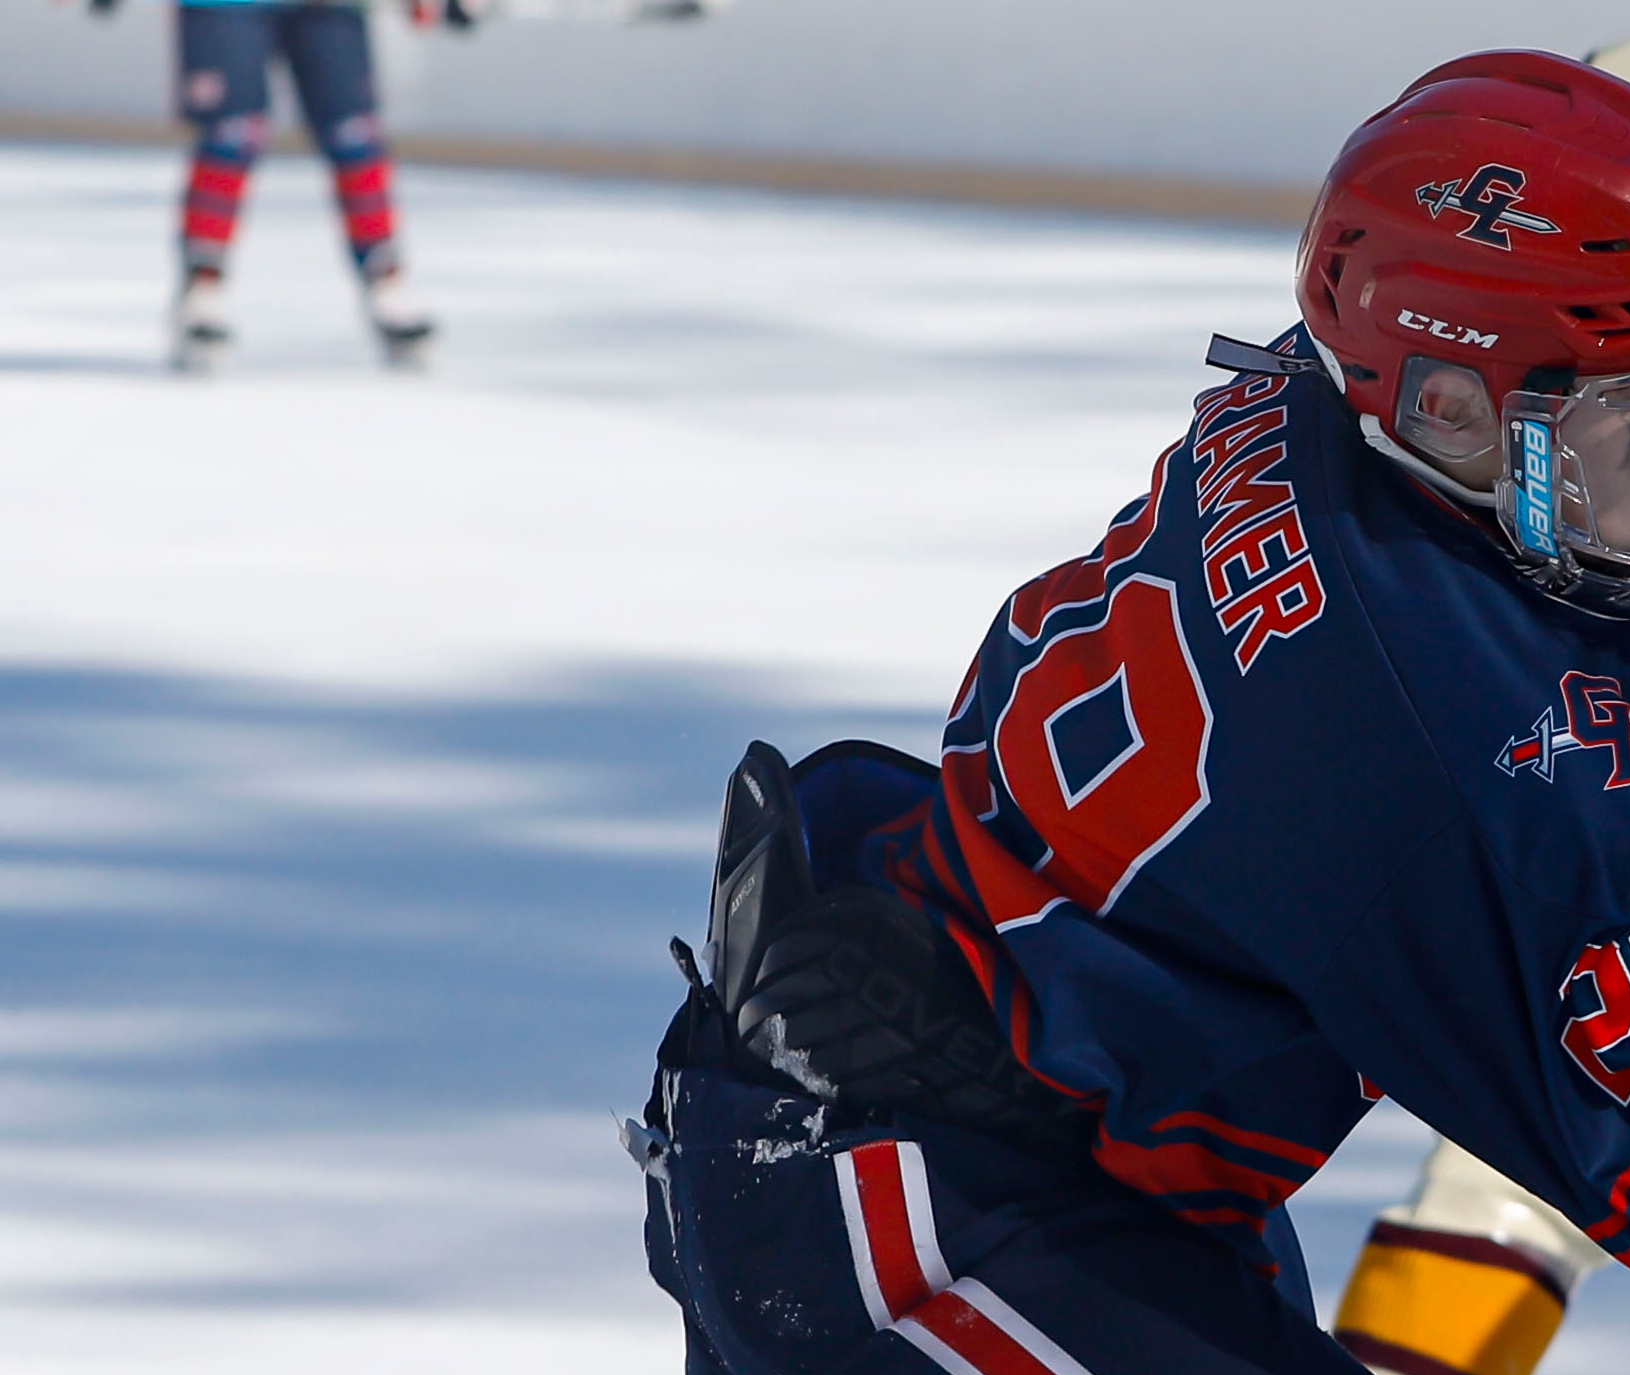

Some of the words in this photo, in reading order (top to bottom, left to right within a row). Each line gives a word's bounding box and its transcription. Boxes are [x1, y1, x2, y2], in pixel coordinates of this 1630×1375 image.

[1398, 308, 1499, 349] CCM
[1194, 333, 1327, 677] RAMER
[1526, 423, 1555, 554] BAUER
